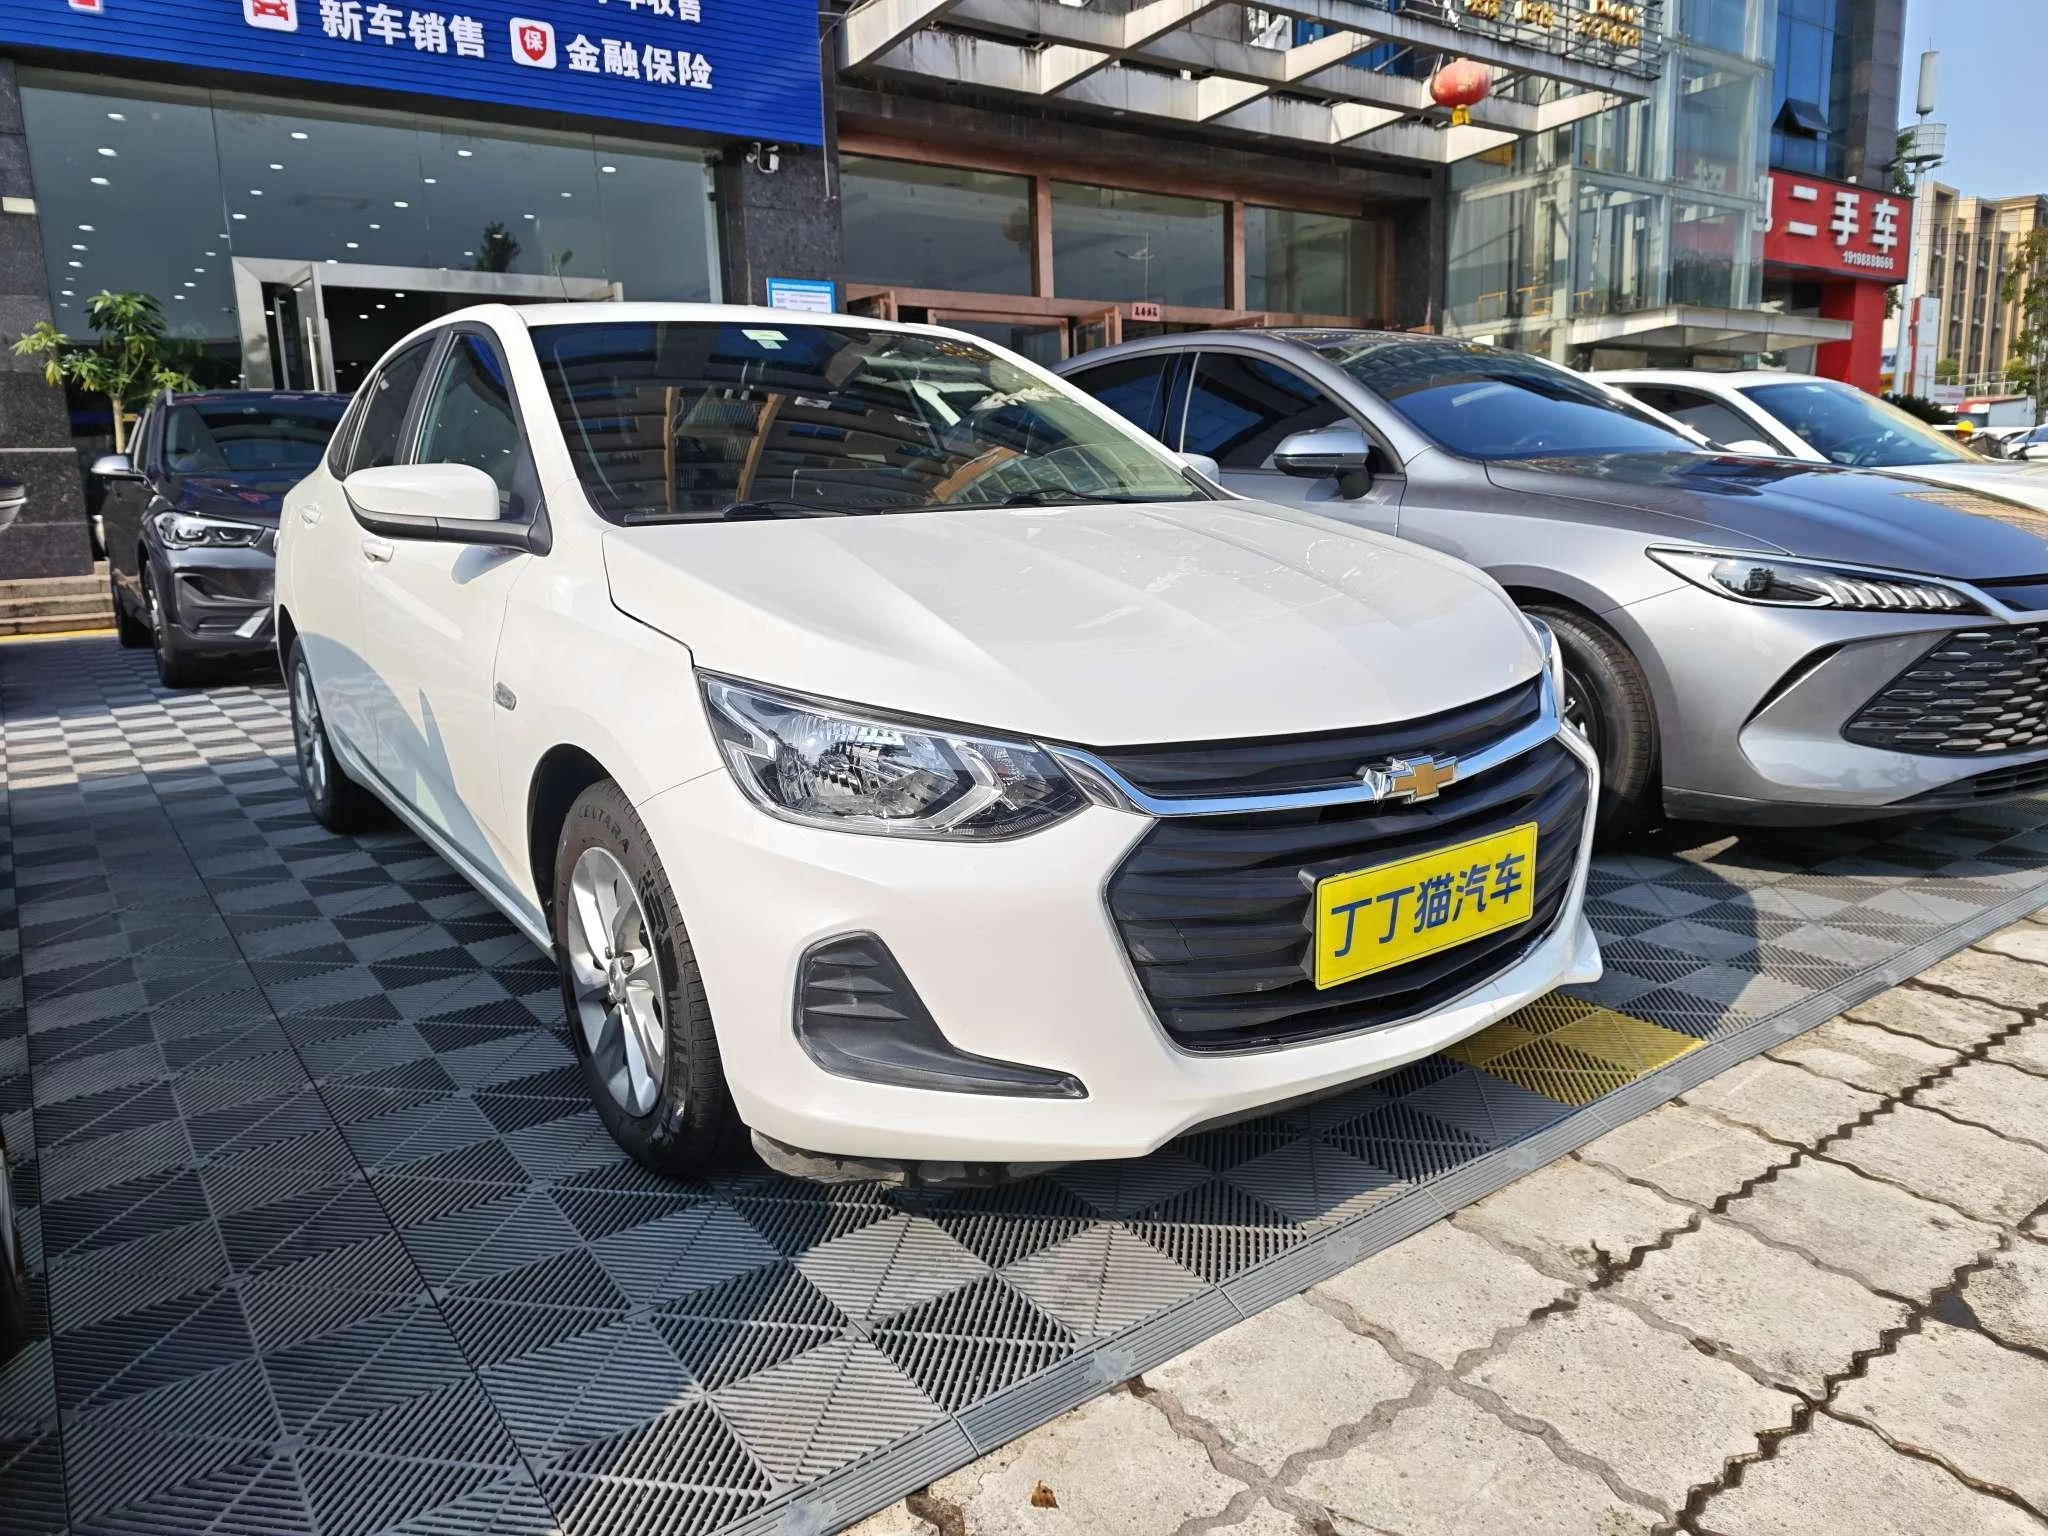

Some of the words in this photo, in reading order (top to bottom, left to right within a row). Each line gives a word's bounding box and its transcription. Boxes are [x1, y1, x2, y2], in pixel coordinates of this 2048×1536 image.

[319, 0, 486, 59] 新车销售
[524, 29, 544, 51] 保
[565, 34, 713, 89] 金融保险
[1764, 175, 1899, 253] 二手车
[1331, 853, 1525, 957] 丁丁猫汽车
